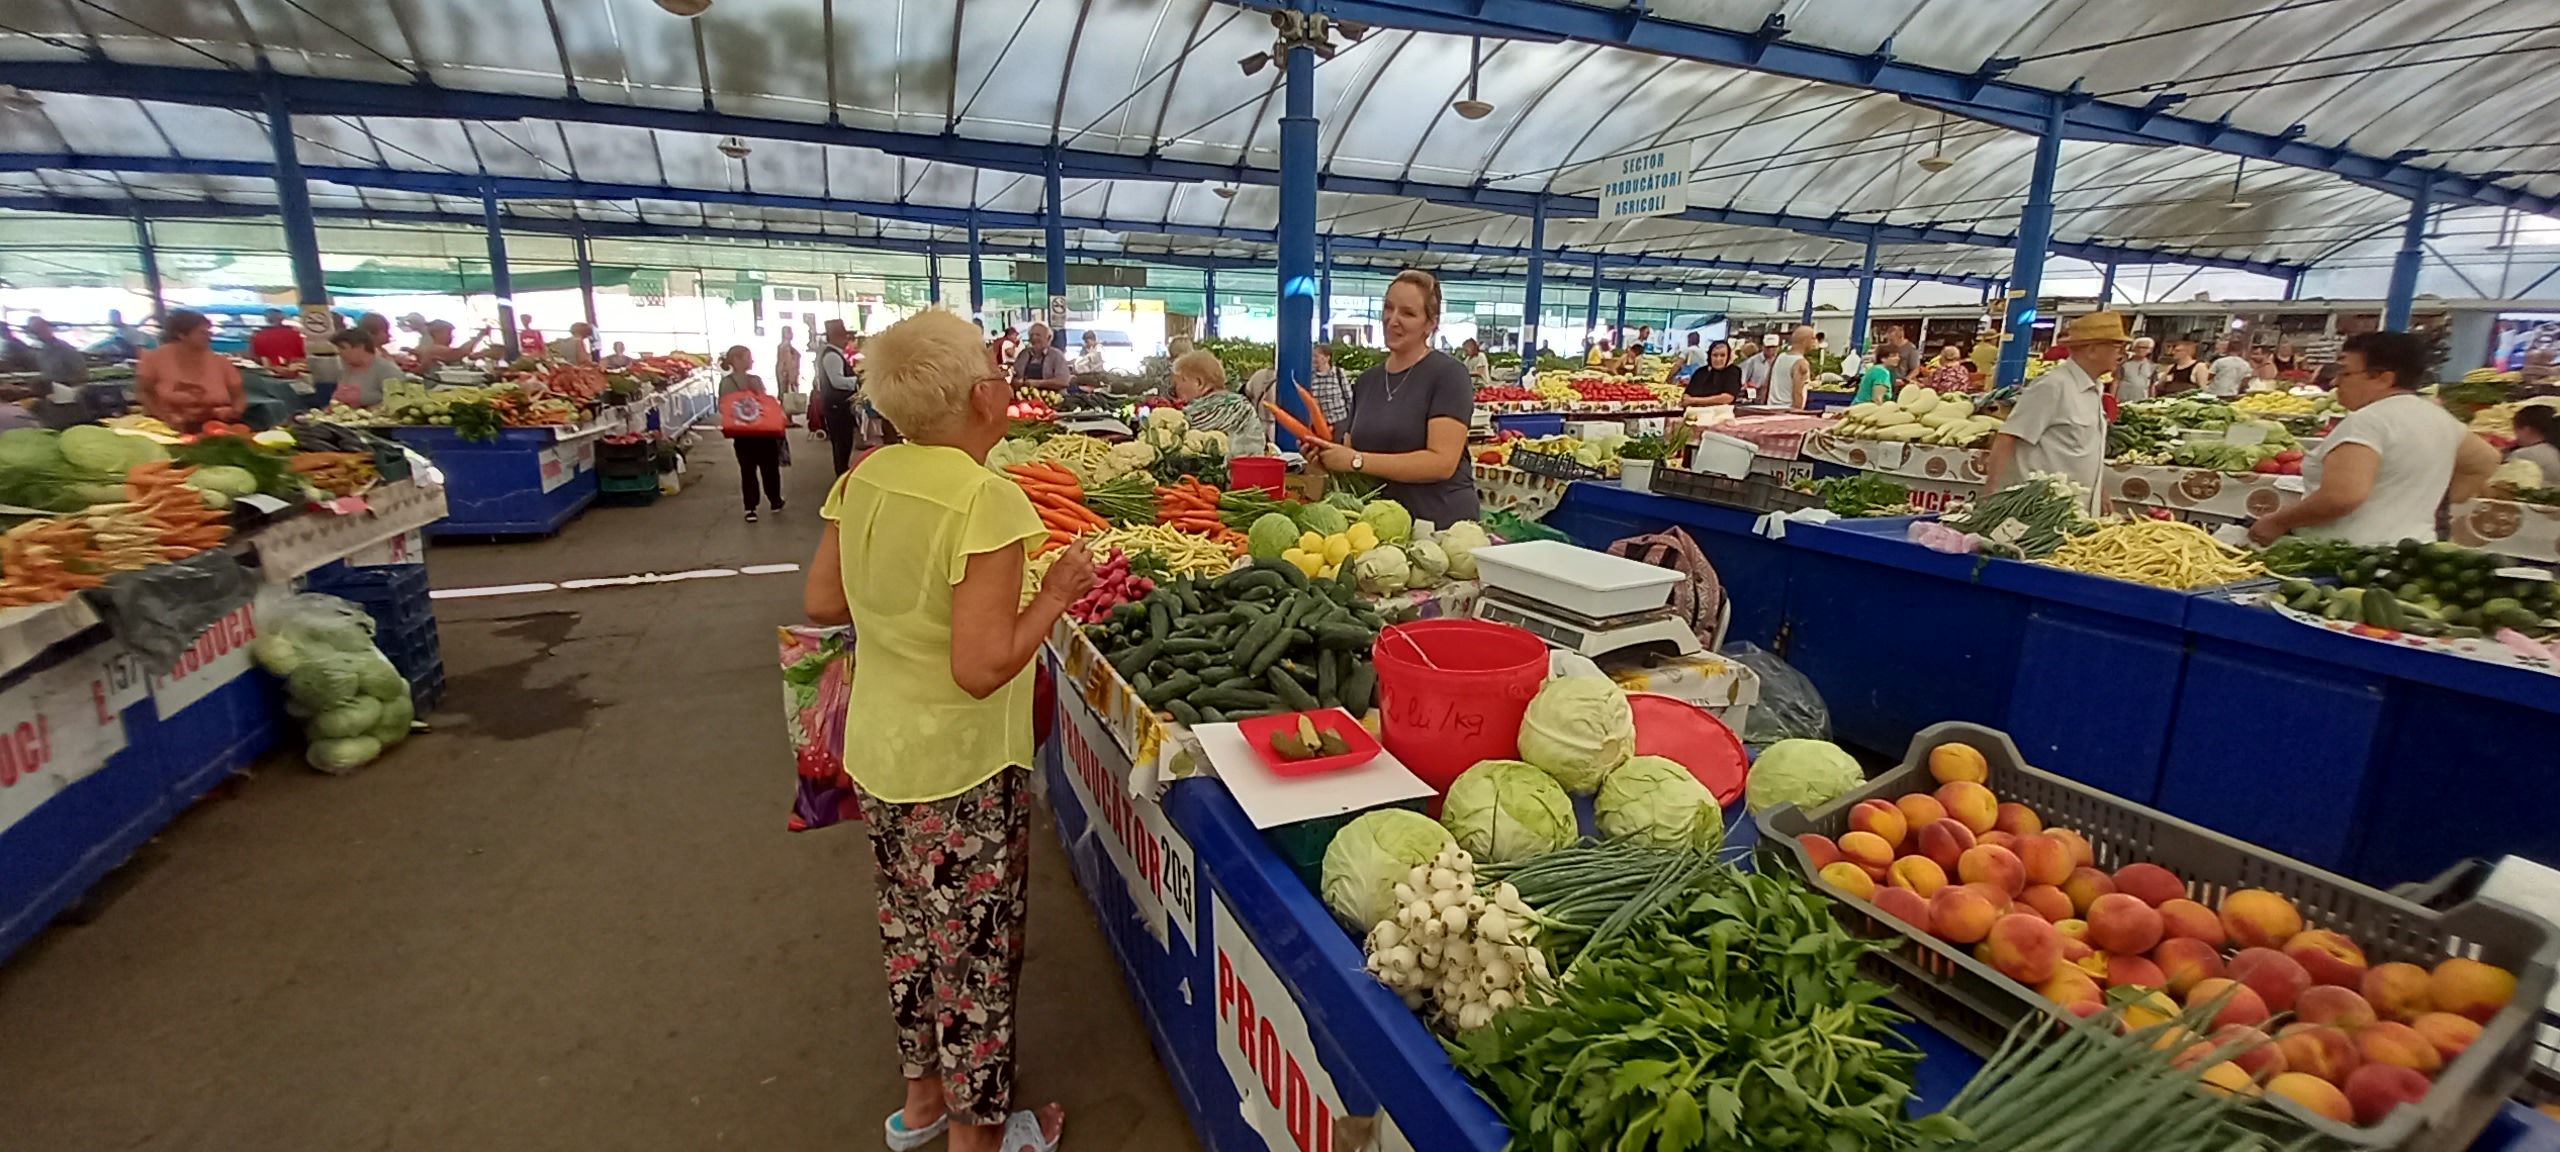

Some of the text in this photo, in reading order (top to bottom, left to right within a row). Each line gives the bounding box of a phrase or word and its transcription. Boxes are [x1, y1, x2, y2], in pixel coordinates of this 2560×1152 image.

[1622, 152, 1665, 175] SECTOR
[1605, 170, 1682, 198] PRODUCĂTORI
[1614, 194, 1666, 216] AGRICOLI
[1060, 701, 1193, 924] PRODUCĂTOR 203
